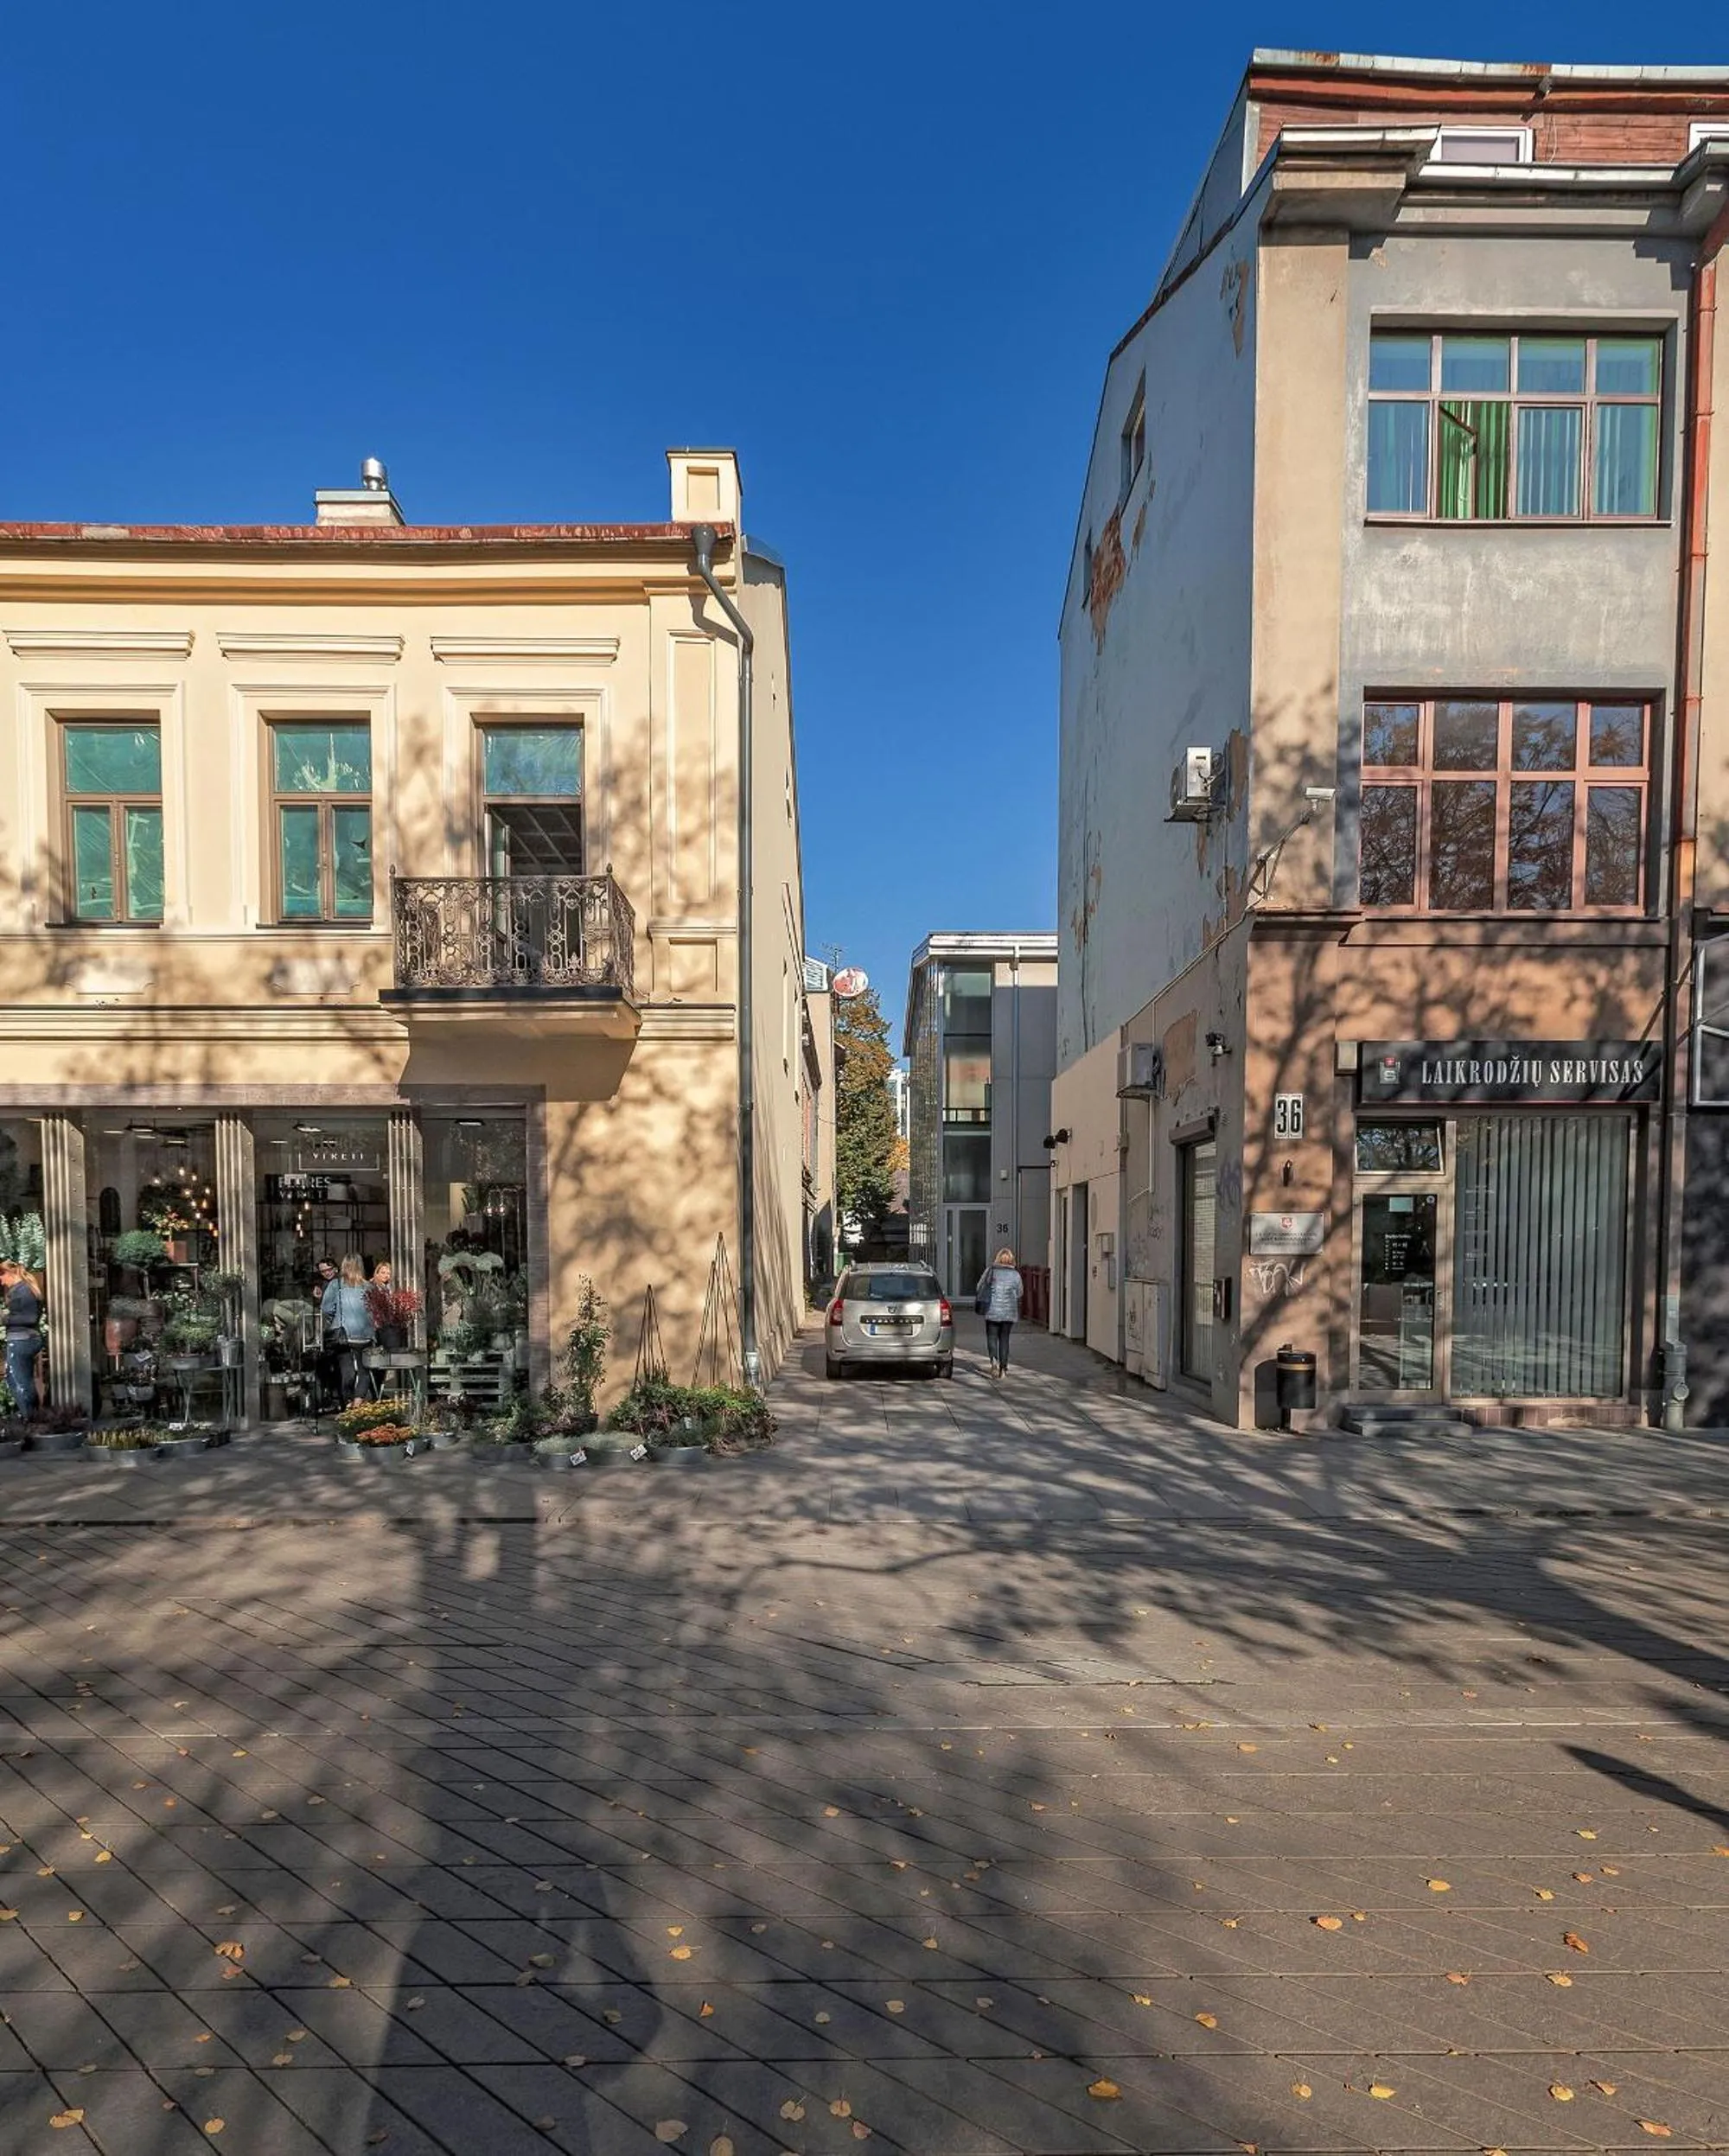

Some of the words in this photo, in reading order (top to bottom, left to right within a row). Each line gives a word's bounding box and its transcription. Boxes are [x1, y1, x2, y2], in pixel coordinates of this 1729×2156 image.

[1422, 1055, 1542, 1088] LAIKRODŽIŲ
[1550, 1060, 1643, 1083] SERVISAS
[1277, 1099, 1301, 1133] 36
[996, 1222, 1009, 1233] 36
